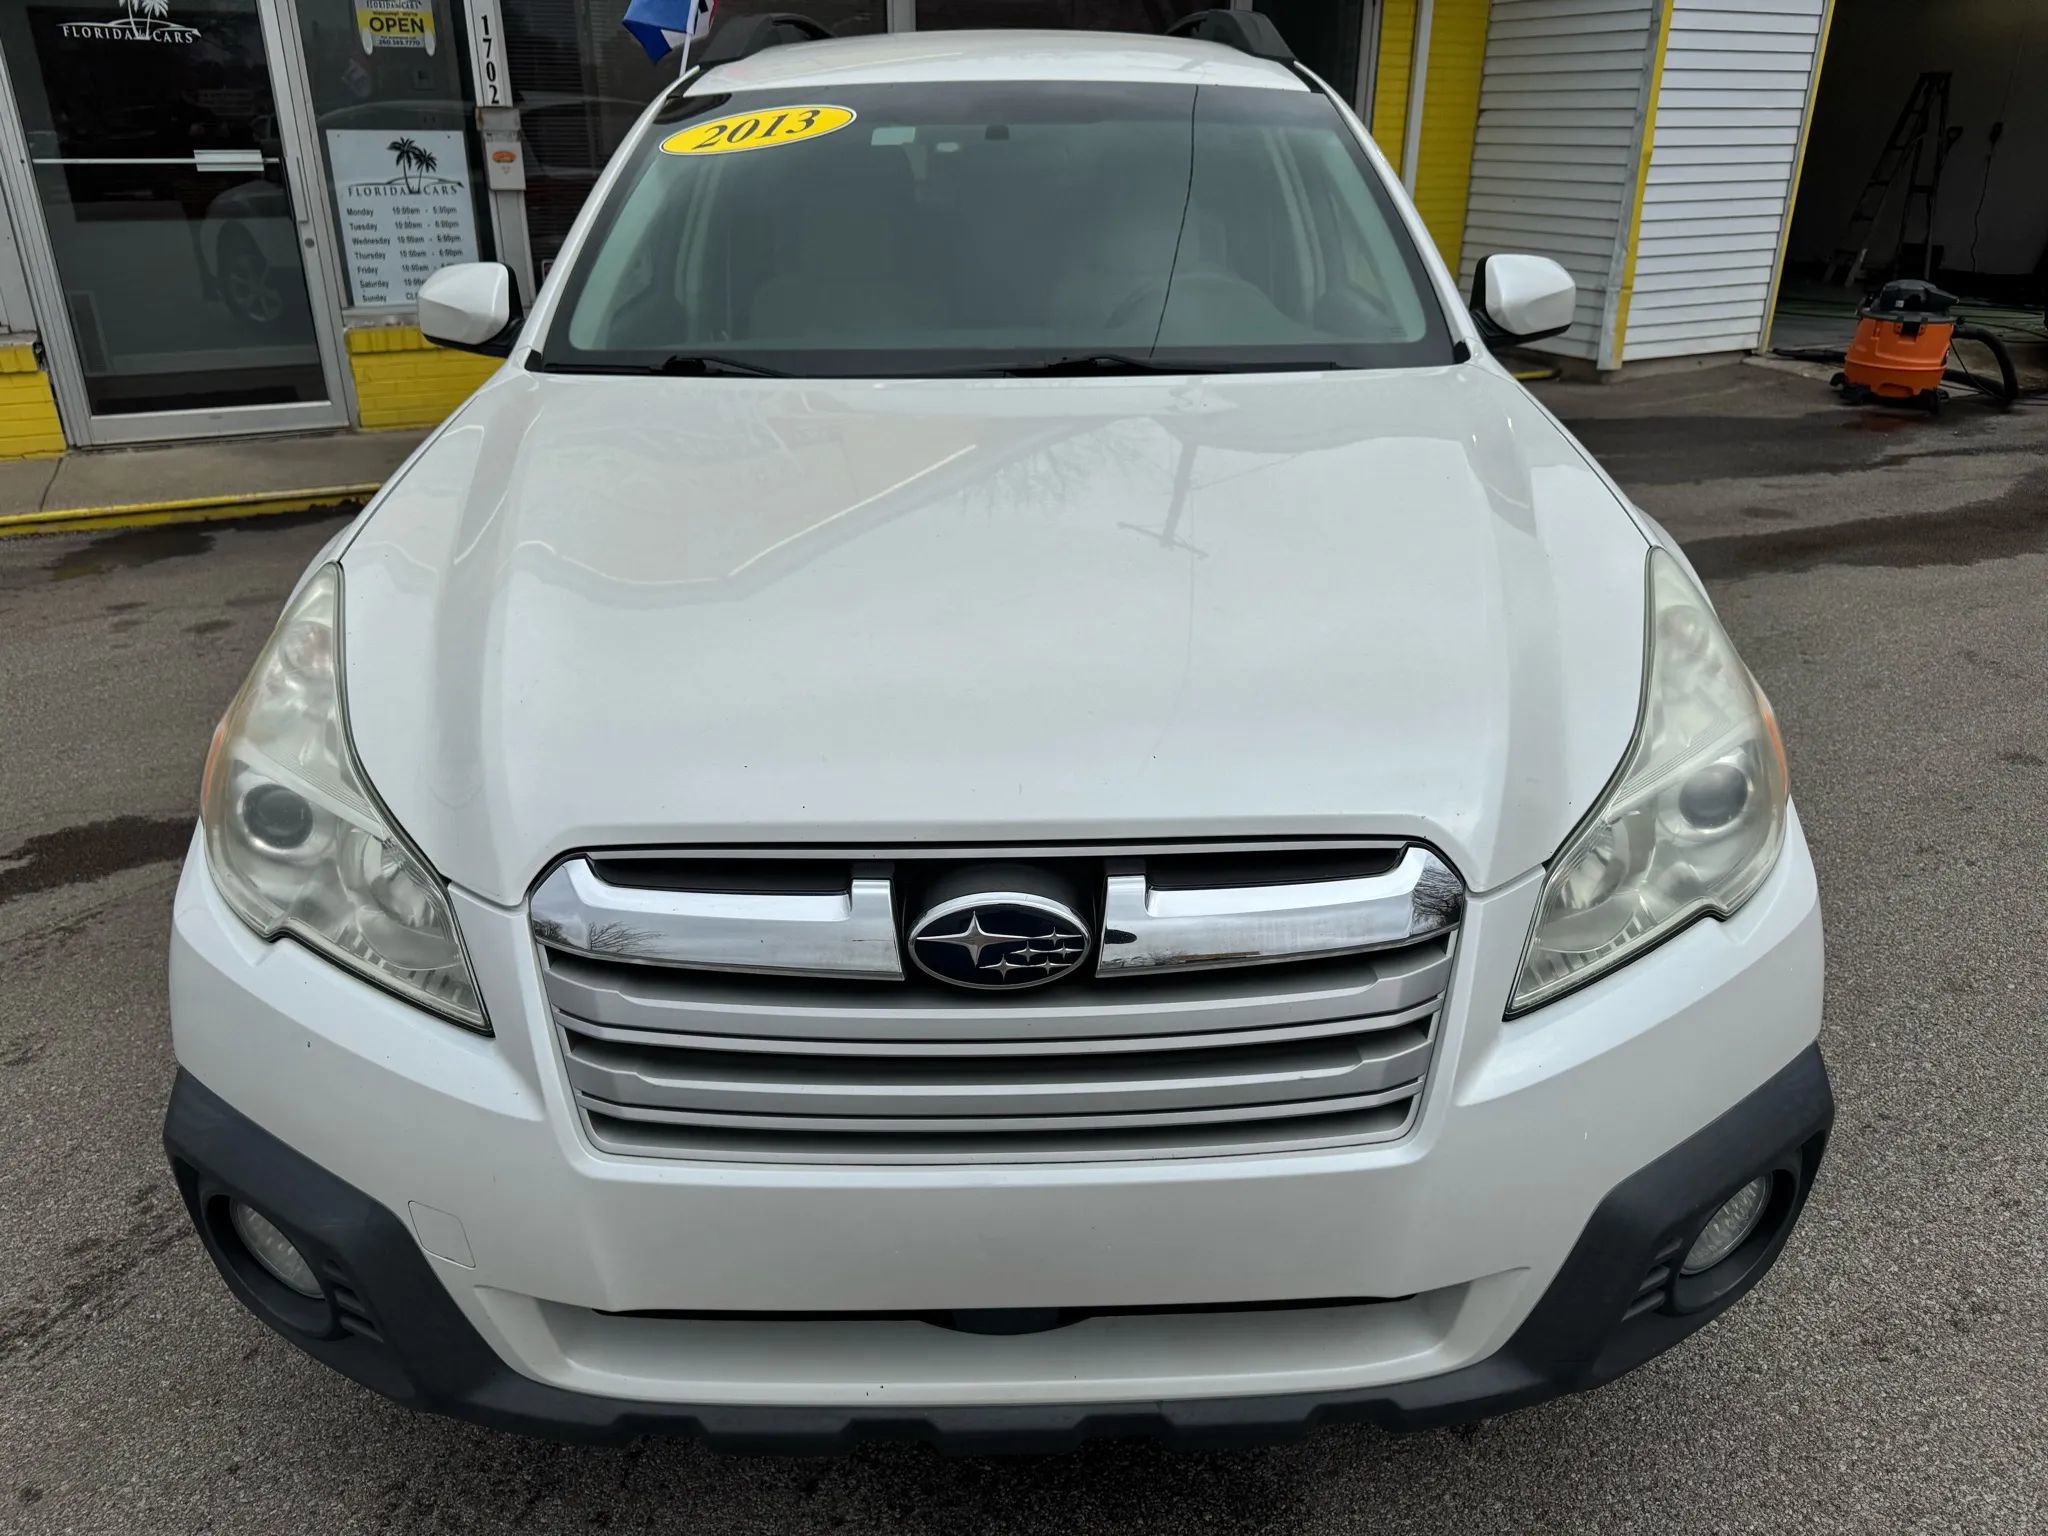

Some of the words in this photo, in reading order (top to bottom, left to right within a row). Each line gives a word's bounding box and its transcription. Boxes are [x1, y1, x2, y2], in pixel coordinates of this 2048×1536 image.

[369, 17, 424, 33] OPEN
[62, 25, 133, 41] FLORIDA
[153, 30, 193, 44] CARS
[481, 14, 499, 105] 1702
[691, 109, 821, 151] 2013
[347, 186, 406, 197] FLORIDA
[423, 185, 458, 195] CARS
[346, 207, 374, 217] Monday
[349, 223, 378, 232] Tuesday
[352, 237, 390, 246] Wednesday
[354, 251, 386, 261] Thursday
[357, 266, 378, 276] Friday
[360, 280, 389, 289] Saturday
[403, 278, 426, 287] 10:00
[362, 294, 387, 303] Sunday
